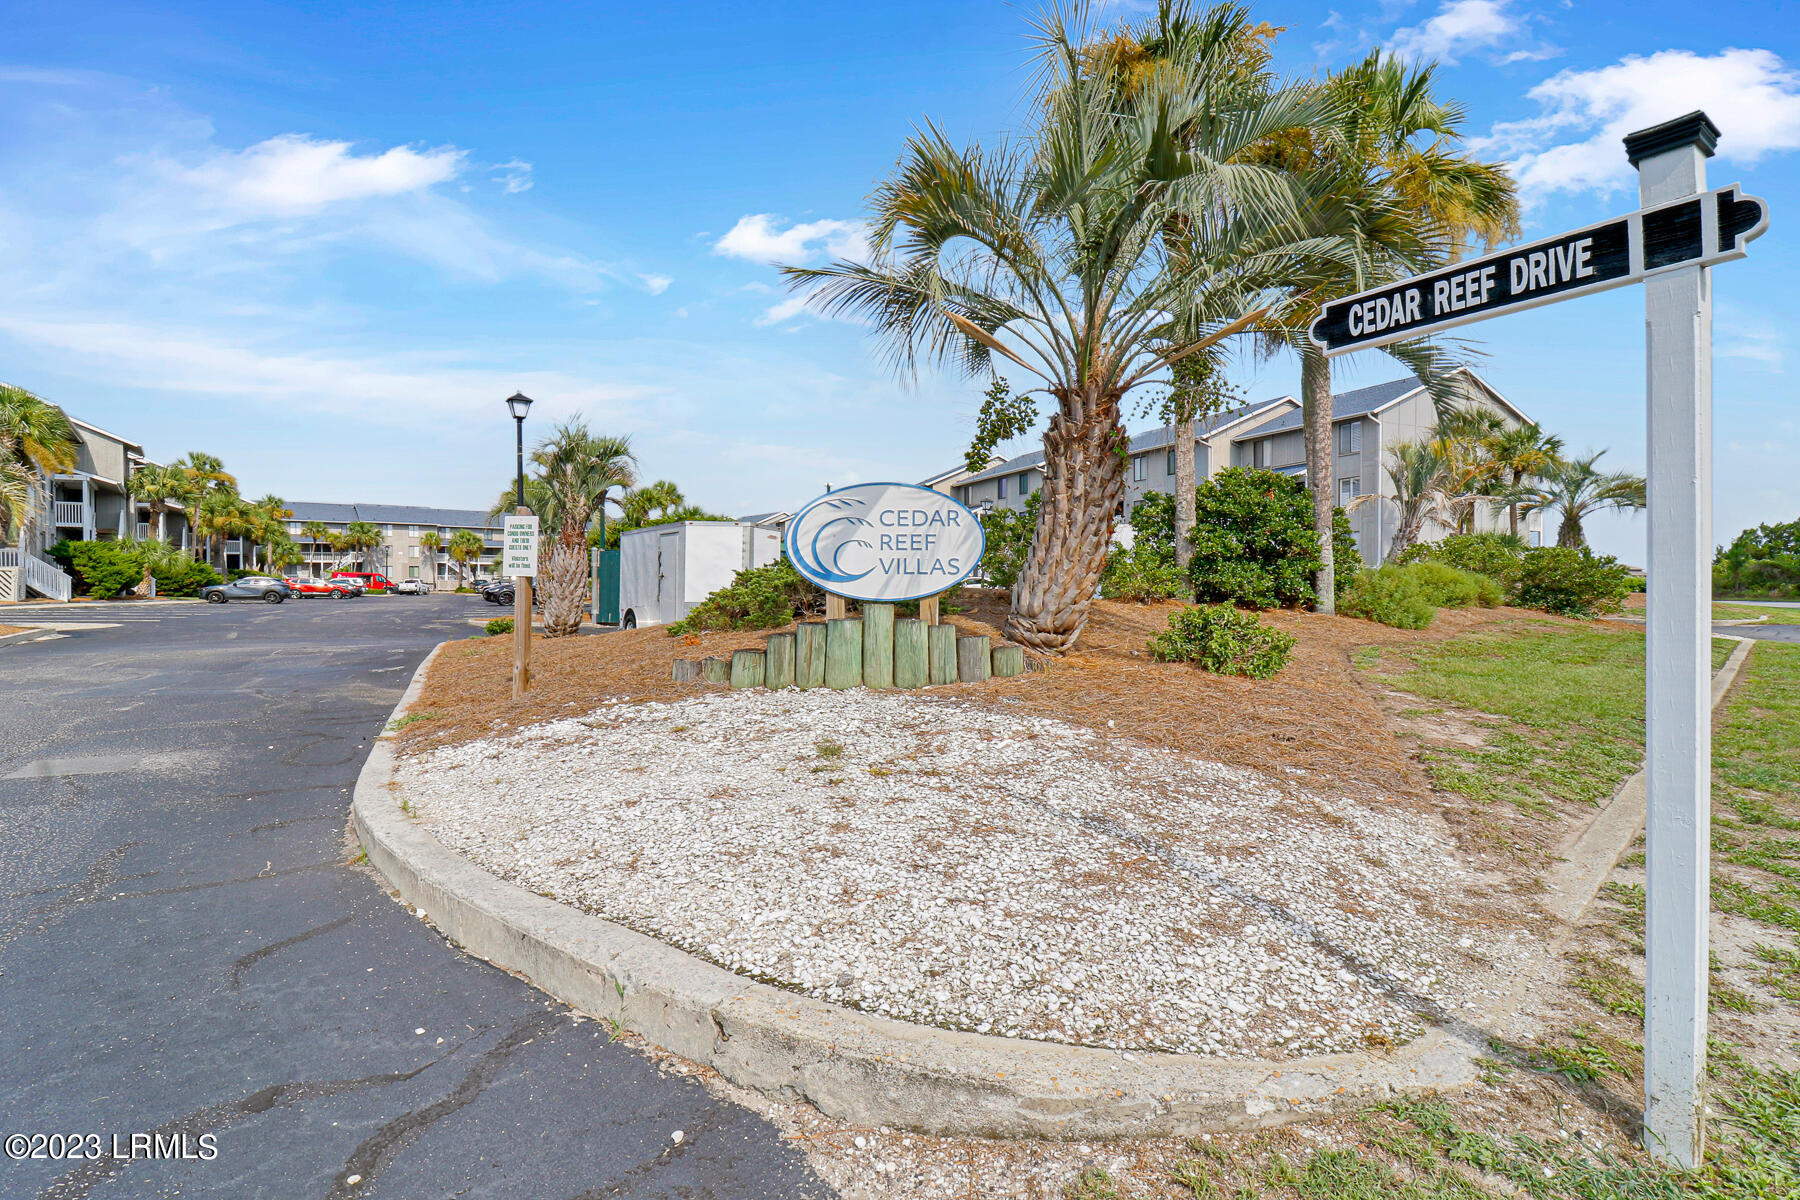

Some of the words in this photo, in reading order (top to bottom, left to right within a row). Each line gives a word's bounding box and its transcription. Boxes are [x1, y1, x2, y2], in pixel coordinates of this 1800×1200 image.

[1348, 287, 1422, 337] CEDAR
[1434, 266, 1496, 316] REEF
[1510, 238, 1595, 295] DRIVE
[879, 509, 961, 527] CEDAR
[880, 534, 936, 551] REEF
[879, 557, 960, 575] VILLAS
